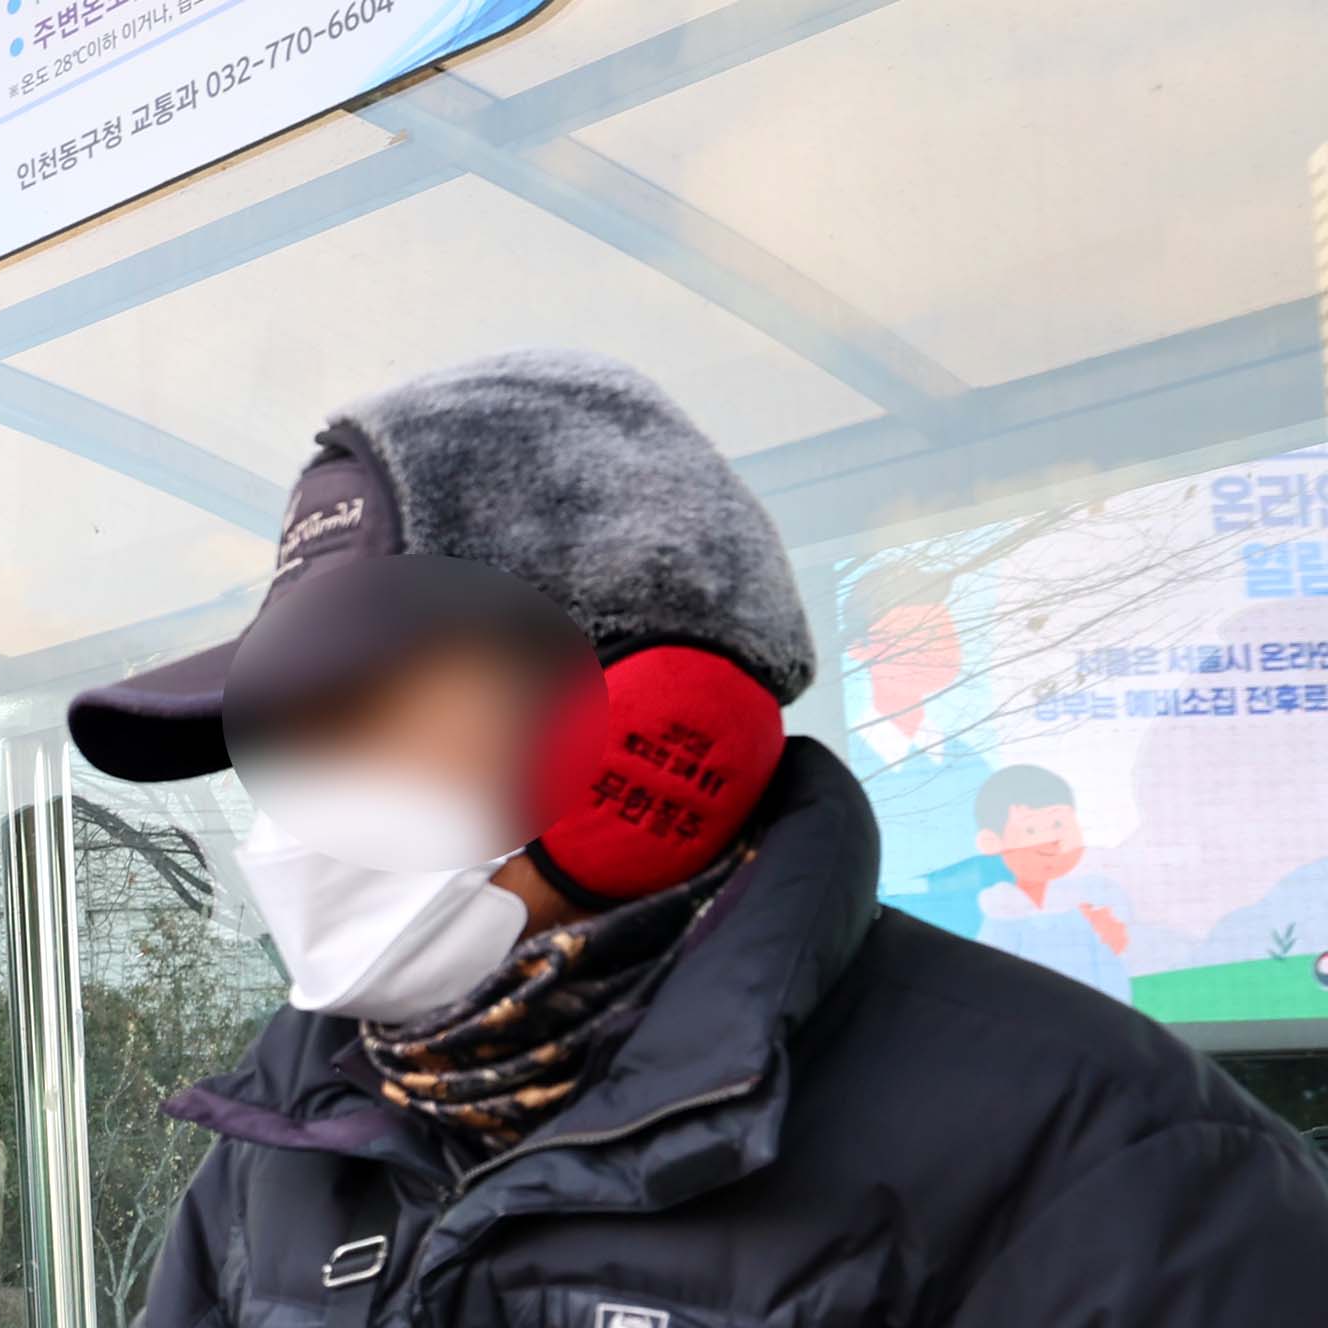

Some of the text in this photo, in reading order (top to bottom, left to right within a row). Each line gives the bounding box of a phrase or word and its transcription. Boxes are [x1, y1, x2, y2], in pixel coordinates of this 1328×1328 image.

[16, 0, 396, 191] 인천동구청 교통과 032-770-6604
[1211, 472, 1328, 532] 온라
